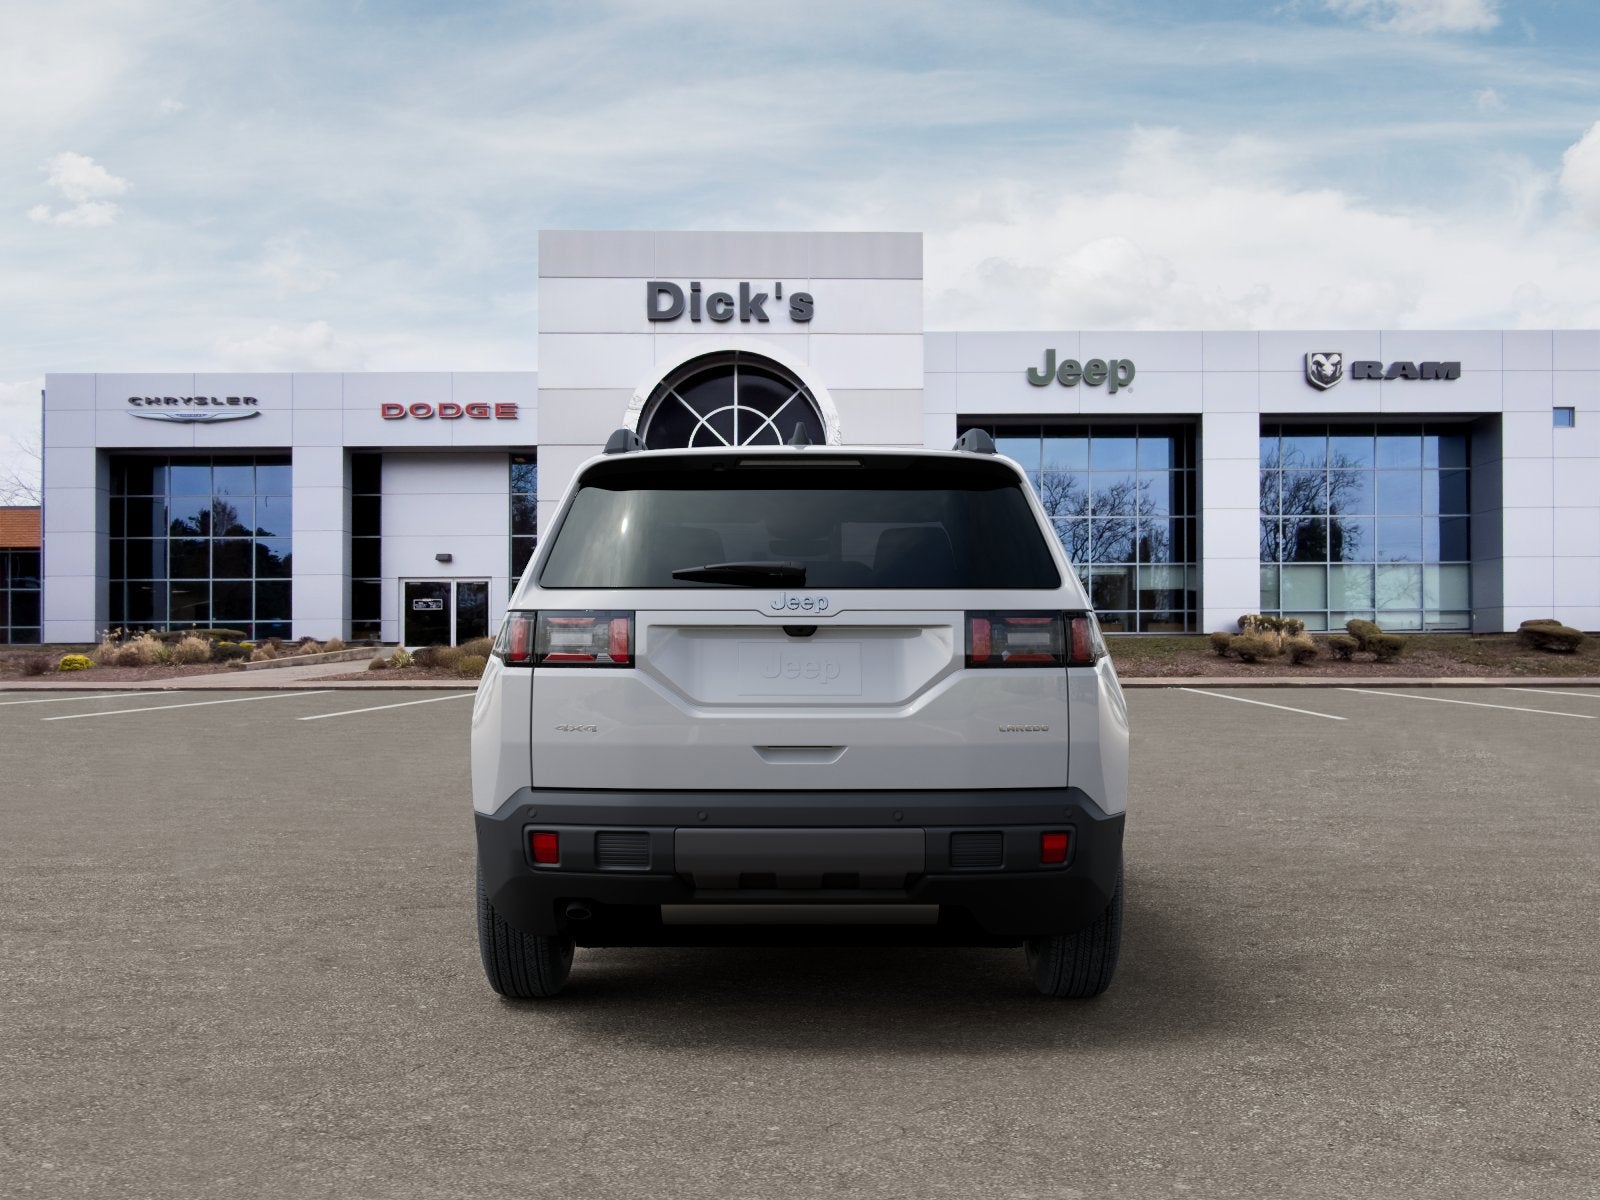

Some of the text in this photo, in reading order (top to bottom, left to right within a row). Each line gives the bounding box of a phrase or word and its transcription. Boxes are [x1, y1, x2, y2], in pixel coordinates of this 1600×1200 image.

[647, 281, 814, 323] Dick's
[1027, 348, 1136, 394] Jeep
[1352, 360, 1461, 381] RAM
[127, 396, 259, 407] CHRYSLER
[381, 402, 519, 420] DODGE
[770, 592, 829, 614] Jeep
[762, 648, 841, 685] Jeep
